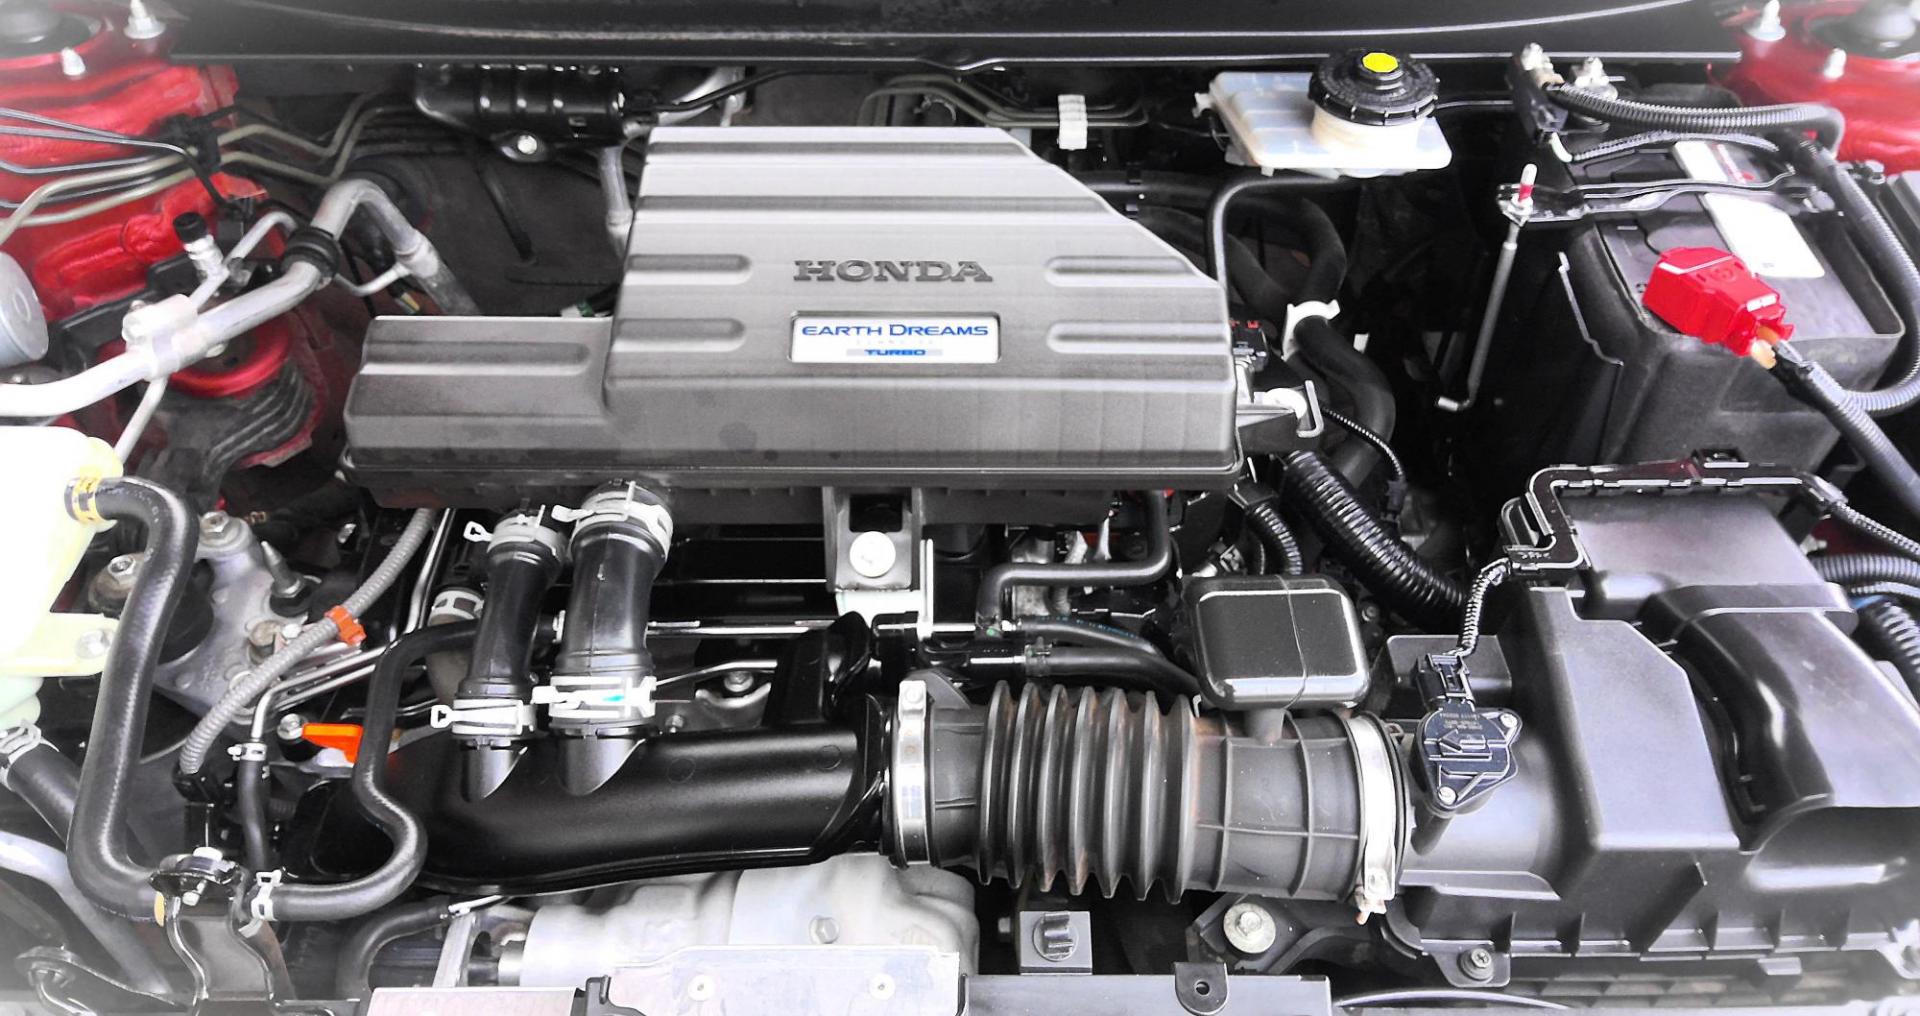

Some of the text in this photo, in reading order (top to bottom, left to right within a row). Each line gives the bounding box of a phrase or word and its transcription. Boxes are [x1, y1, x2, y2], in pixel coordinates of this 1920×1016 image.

[793, 260, 993, 282] HONDA
[801, 324, 989, 336] EARTH DREAMS
[864, 348, 927, 357] TURBO
